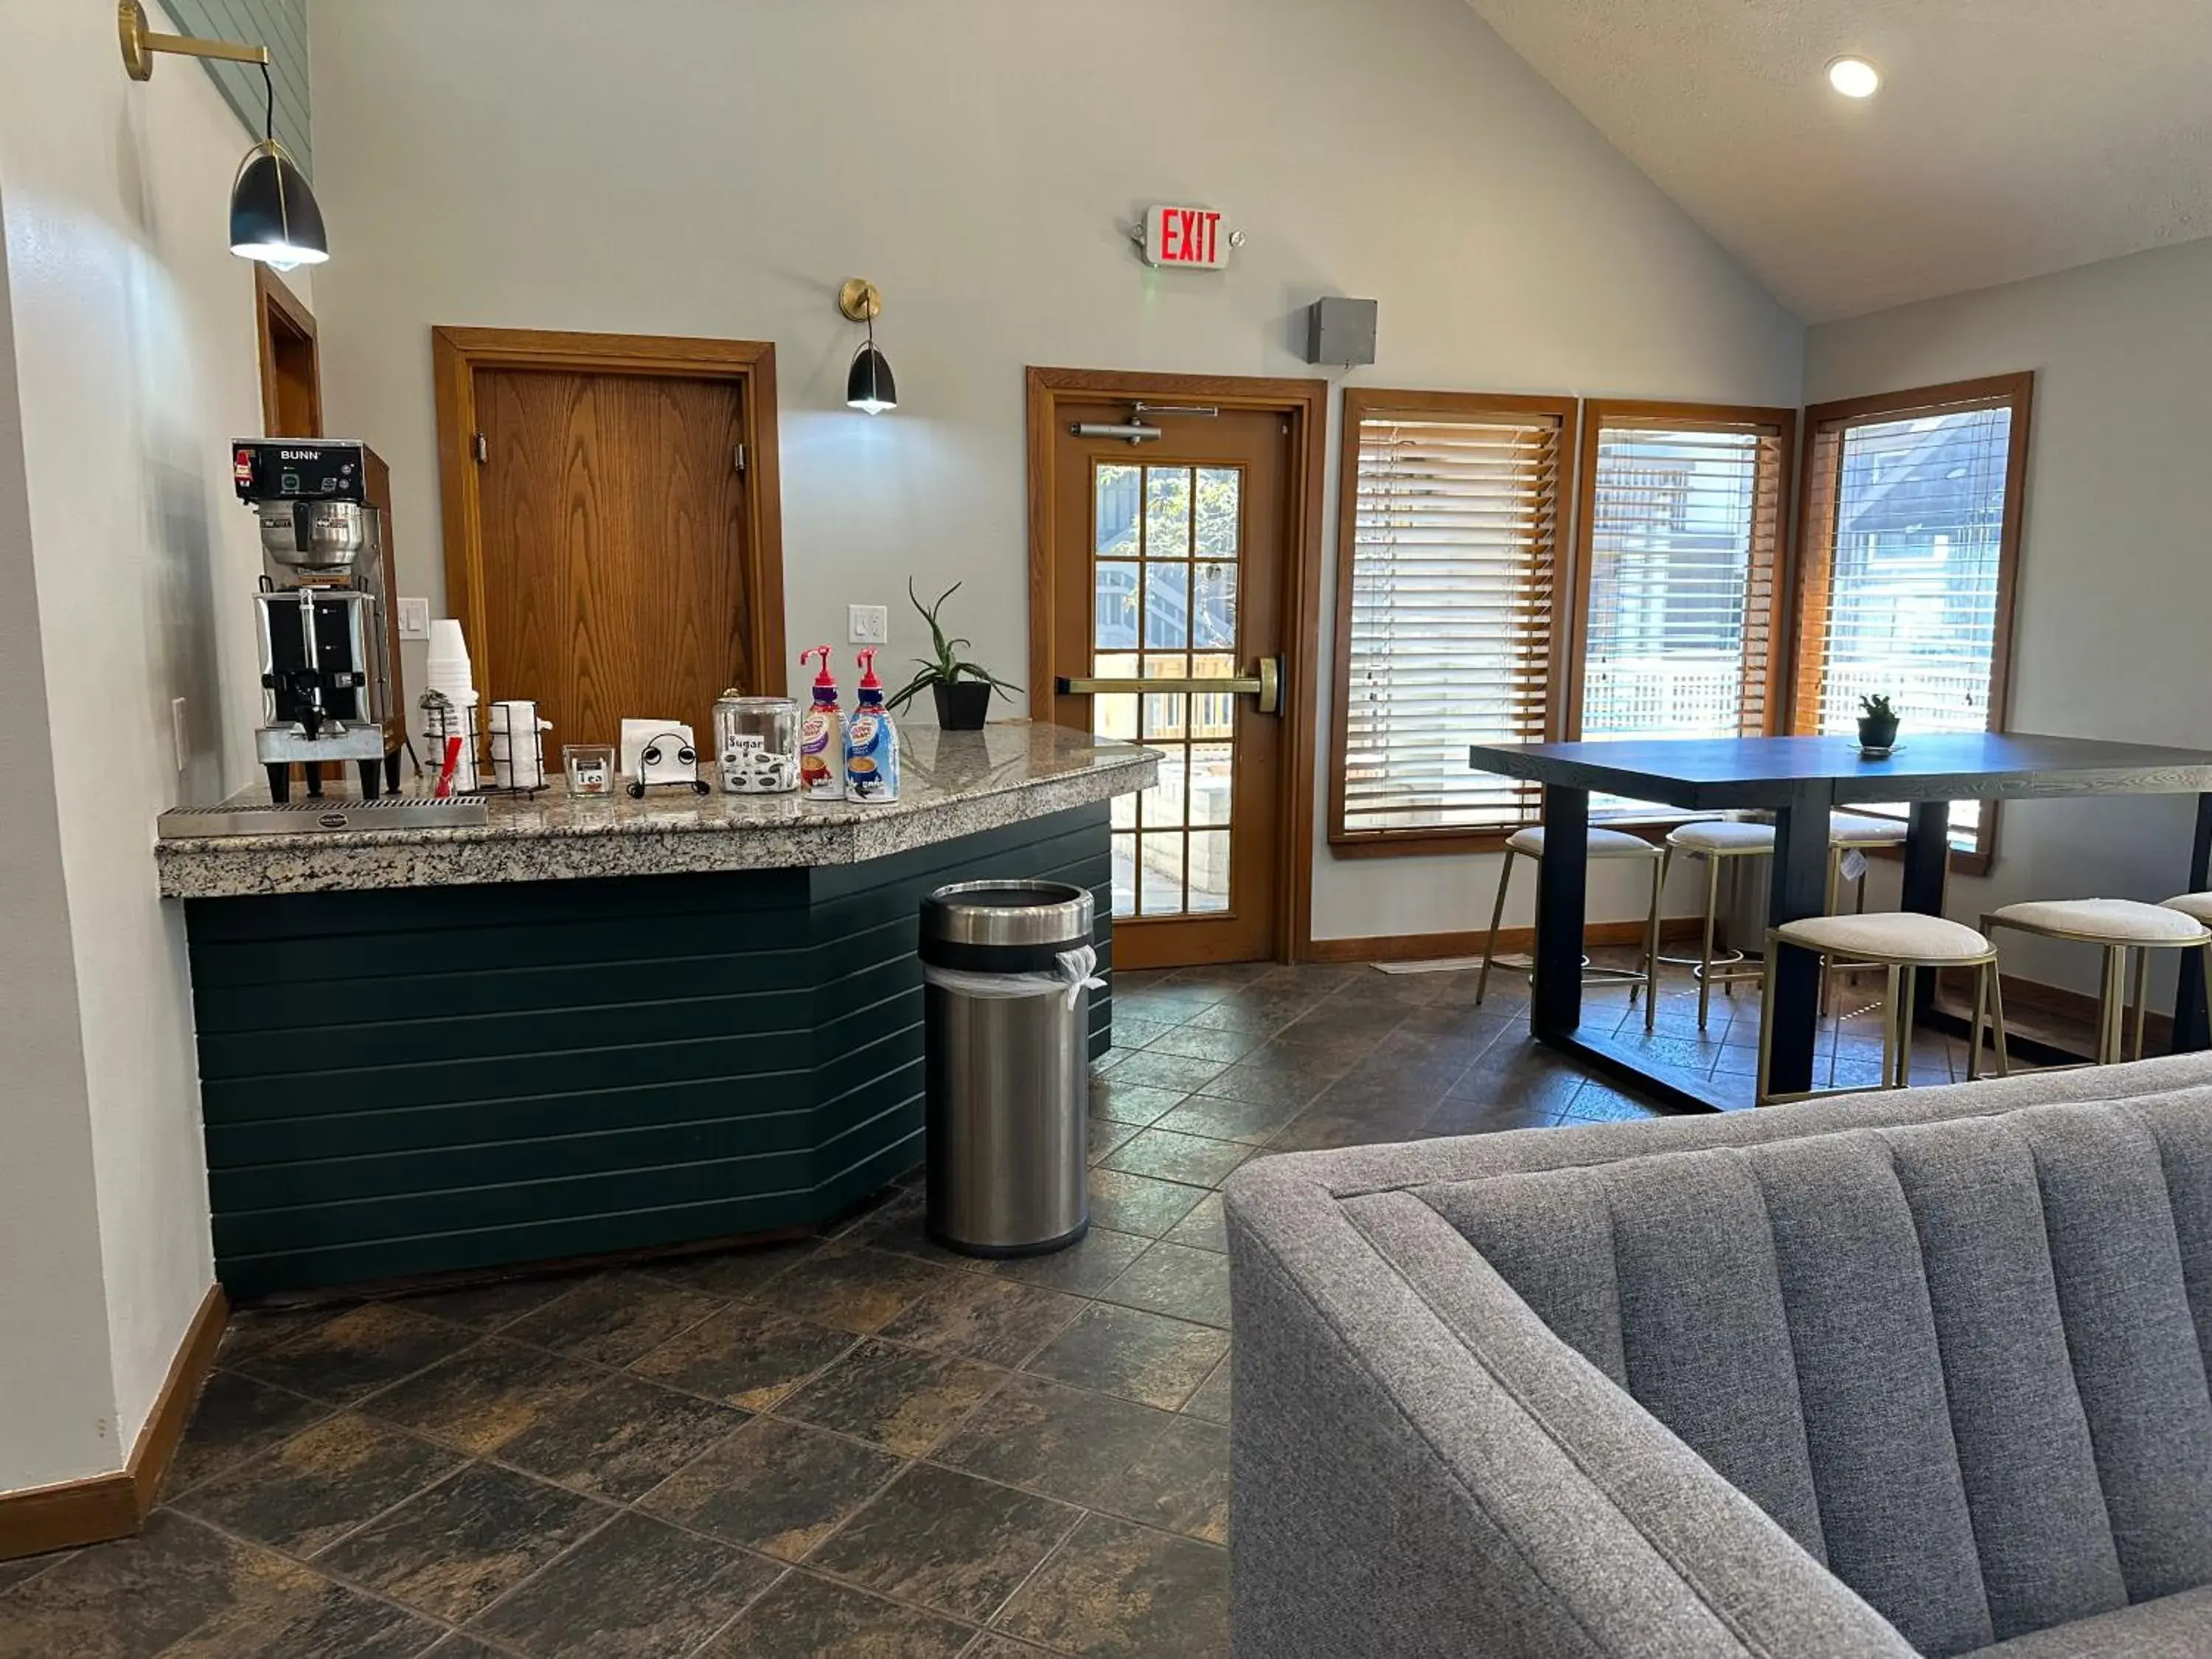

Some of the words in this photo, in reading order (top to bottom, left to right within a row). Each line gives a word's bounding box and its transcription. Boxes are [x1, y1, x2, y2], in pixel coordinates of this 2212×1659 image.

[1161, 209, 1220, 262] EXIT
[281, 451, 319, 460] BUNN
[729, 737, 762, 751] Sugar
